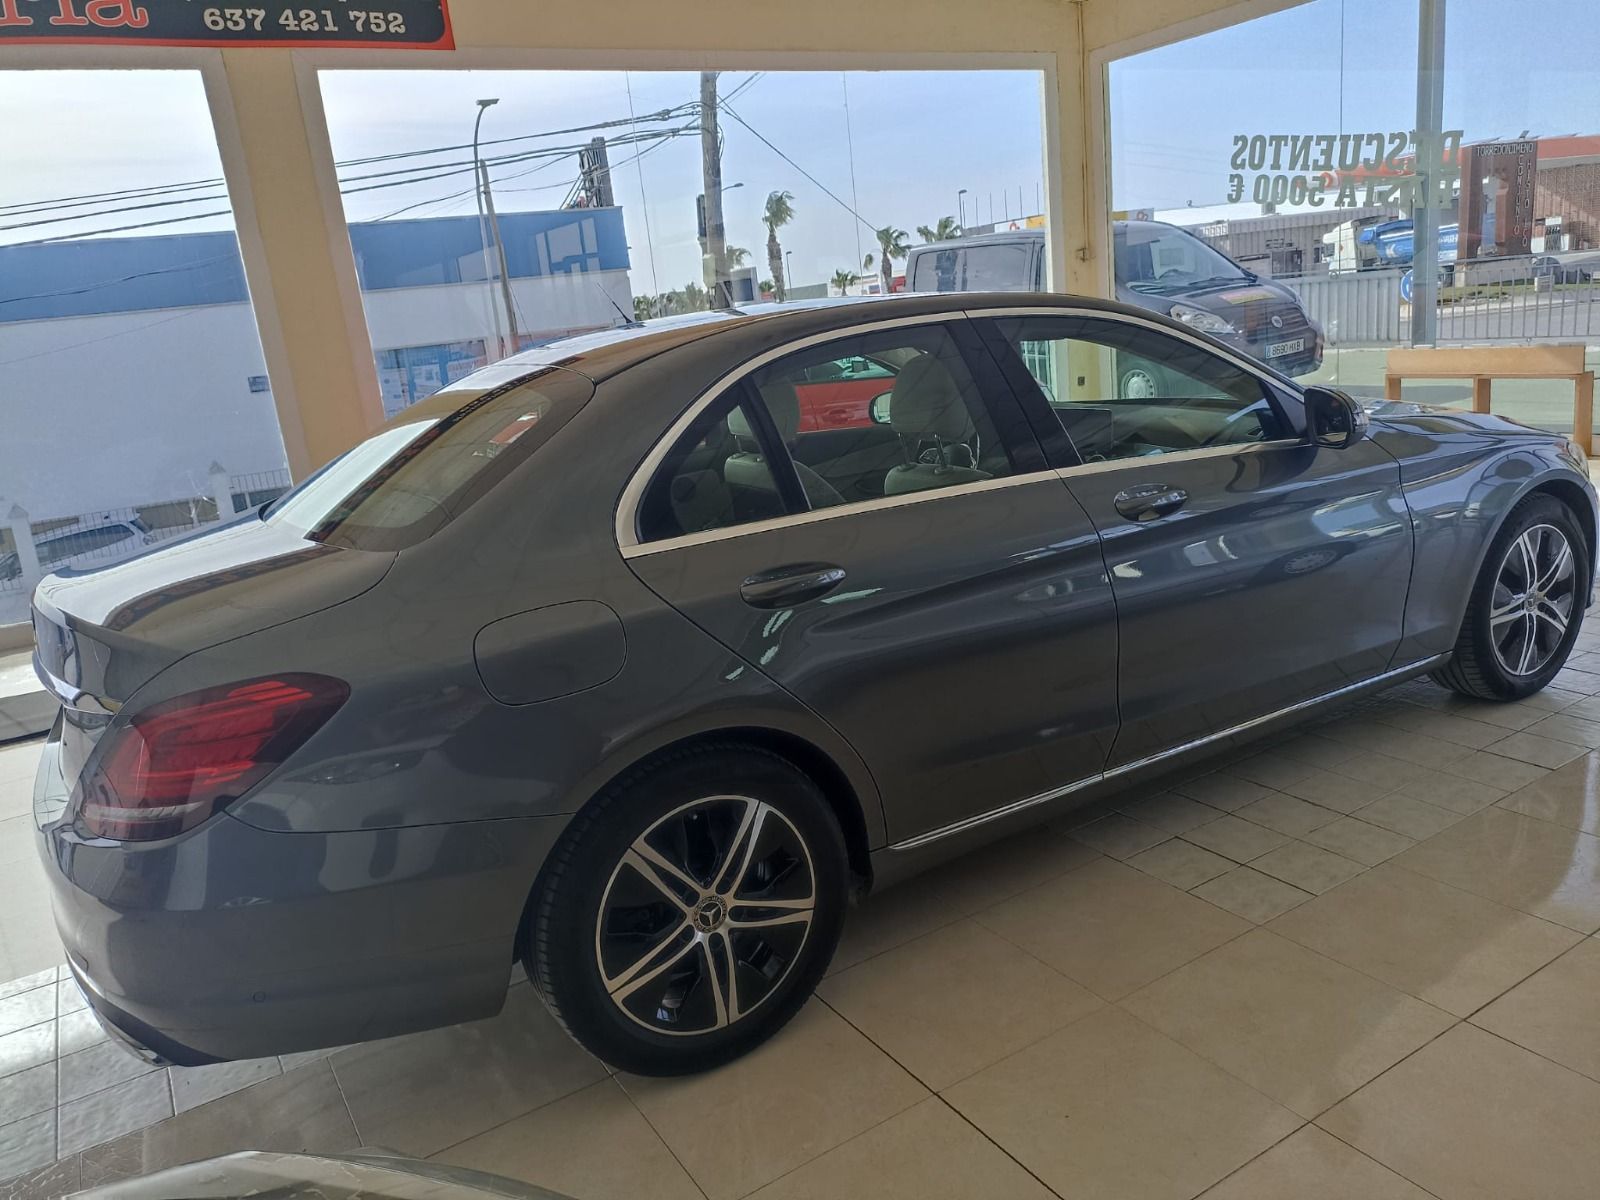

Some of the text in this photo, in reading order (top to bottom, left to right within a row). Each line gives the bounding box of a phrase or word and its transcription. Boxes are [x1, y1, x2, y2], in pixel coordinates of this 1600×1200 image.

[203, 8, 406, 34] 637 421 752
